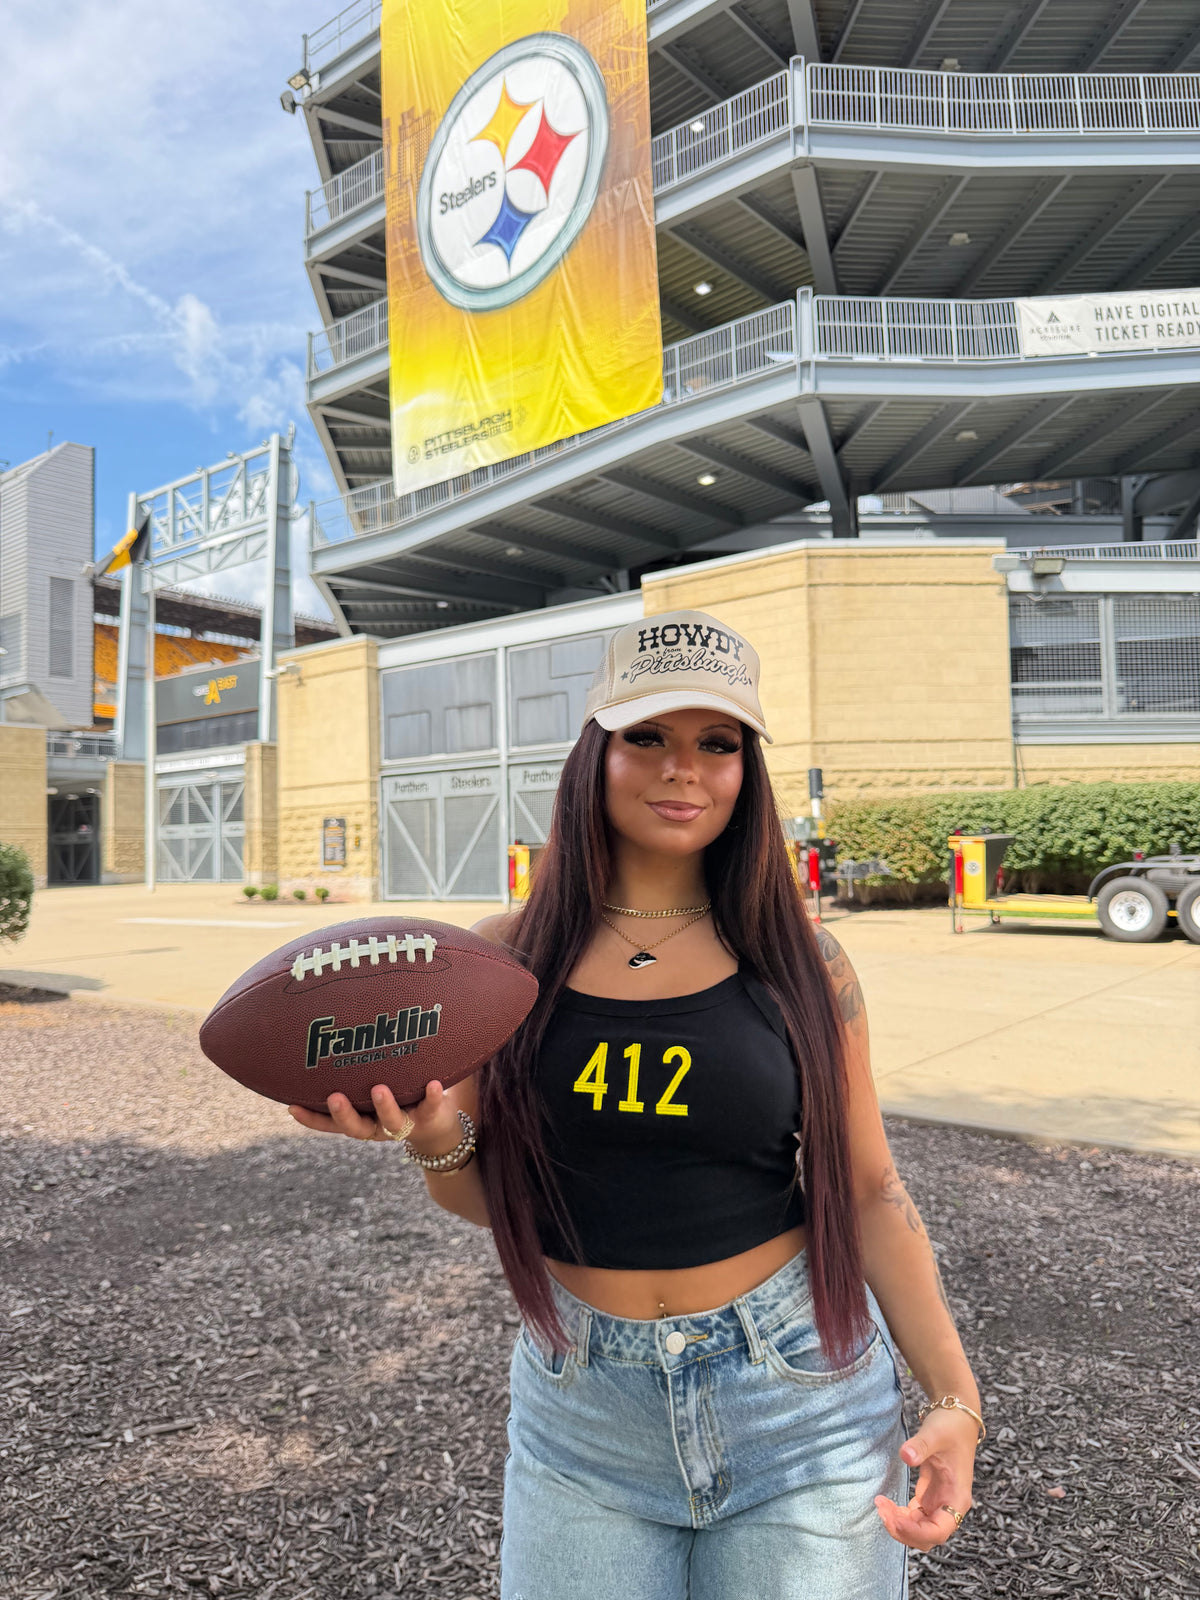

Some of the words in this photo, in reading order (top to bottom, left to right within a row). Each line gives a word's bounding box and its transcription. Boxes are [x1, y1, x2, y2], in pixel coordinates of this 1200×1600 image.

[439, 171, 497, 215] Steelers
[1095, 305, 1134, 321] HAVE
[1140, 301, 1200, 318] DIGITAL
[1096, 323, 1149, 341] TICKET
[424, 408, 513, 450] PITTSBURGH
[424, 430, 490, 460] STEELERS
[638, 624, 743, 661] HOWDY
[662, 647, 681, 656] from
[630, 648, 748, 685] Pittsburgh
[333, 1053, 388, 1069] OFFICIAL
[391, 1042, 419, 1059] SIZE
[573, 1042, 692, 1117] 412
